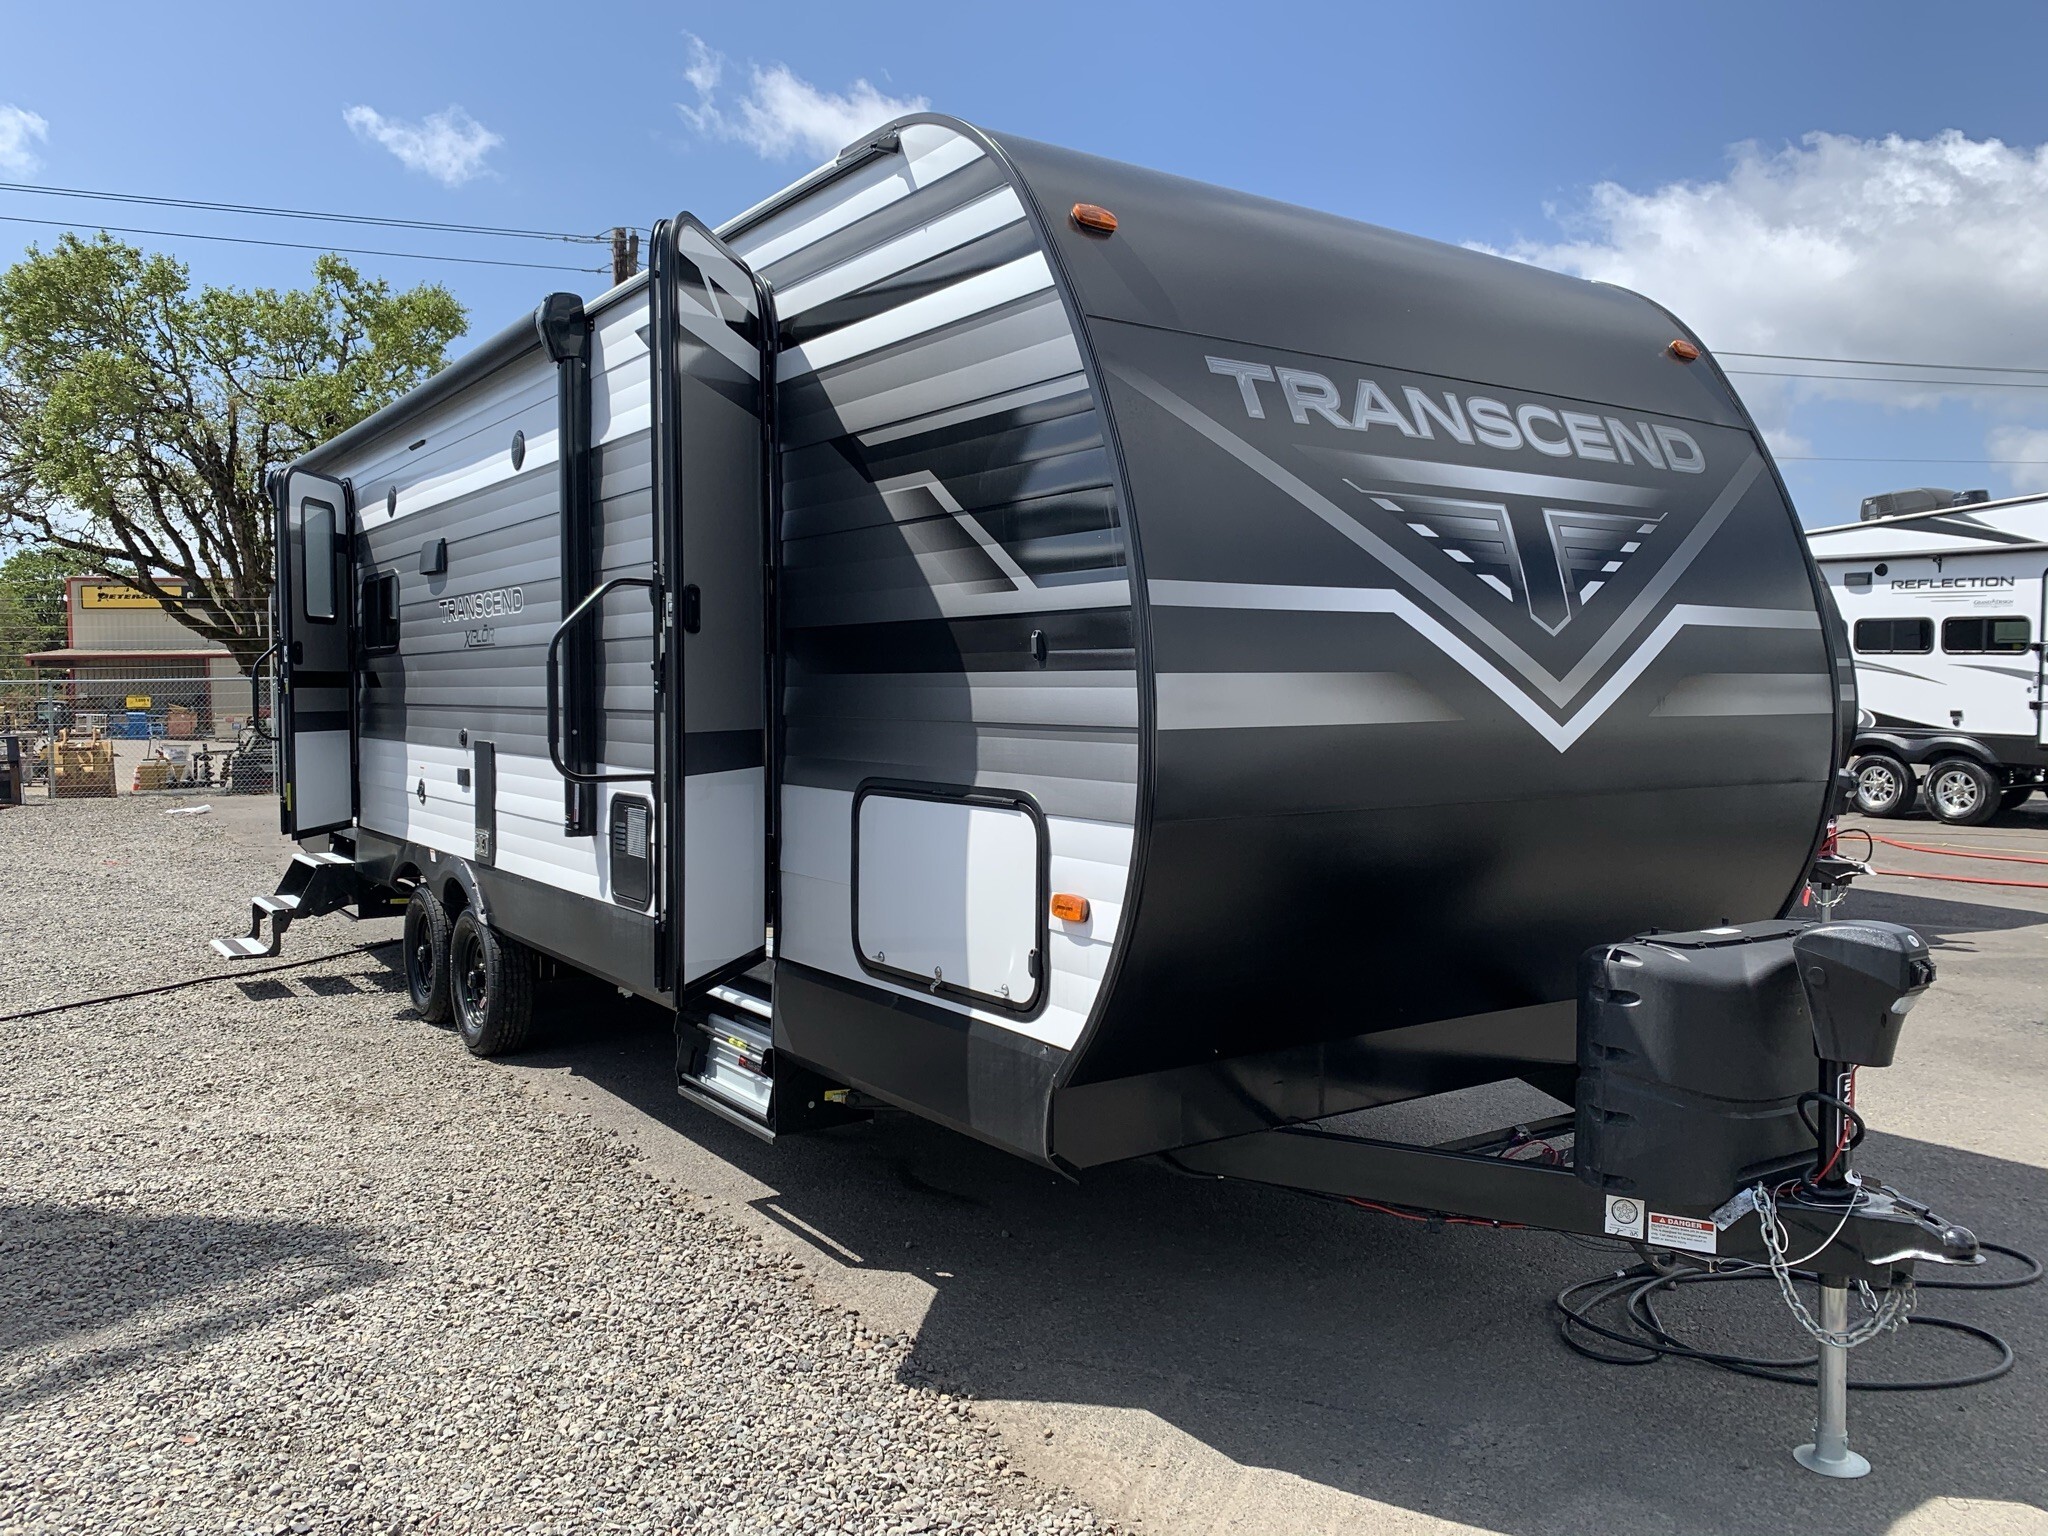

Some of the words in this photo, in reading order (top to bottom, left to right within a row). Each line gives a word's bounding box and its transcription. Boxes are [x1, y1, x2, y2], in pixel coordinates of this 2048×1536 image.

[1204, 355, 1706, 474] TRANSCEND
[1891, 576, 2015, 590] REFLECTION
[438, 586, 524, 623] TRANSCEND
[1667, 1218, 1703, 1230] DANGER
